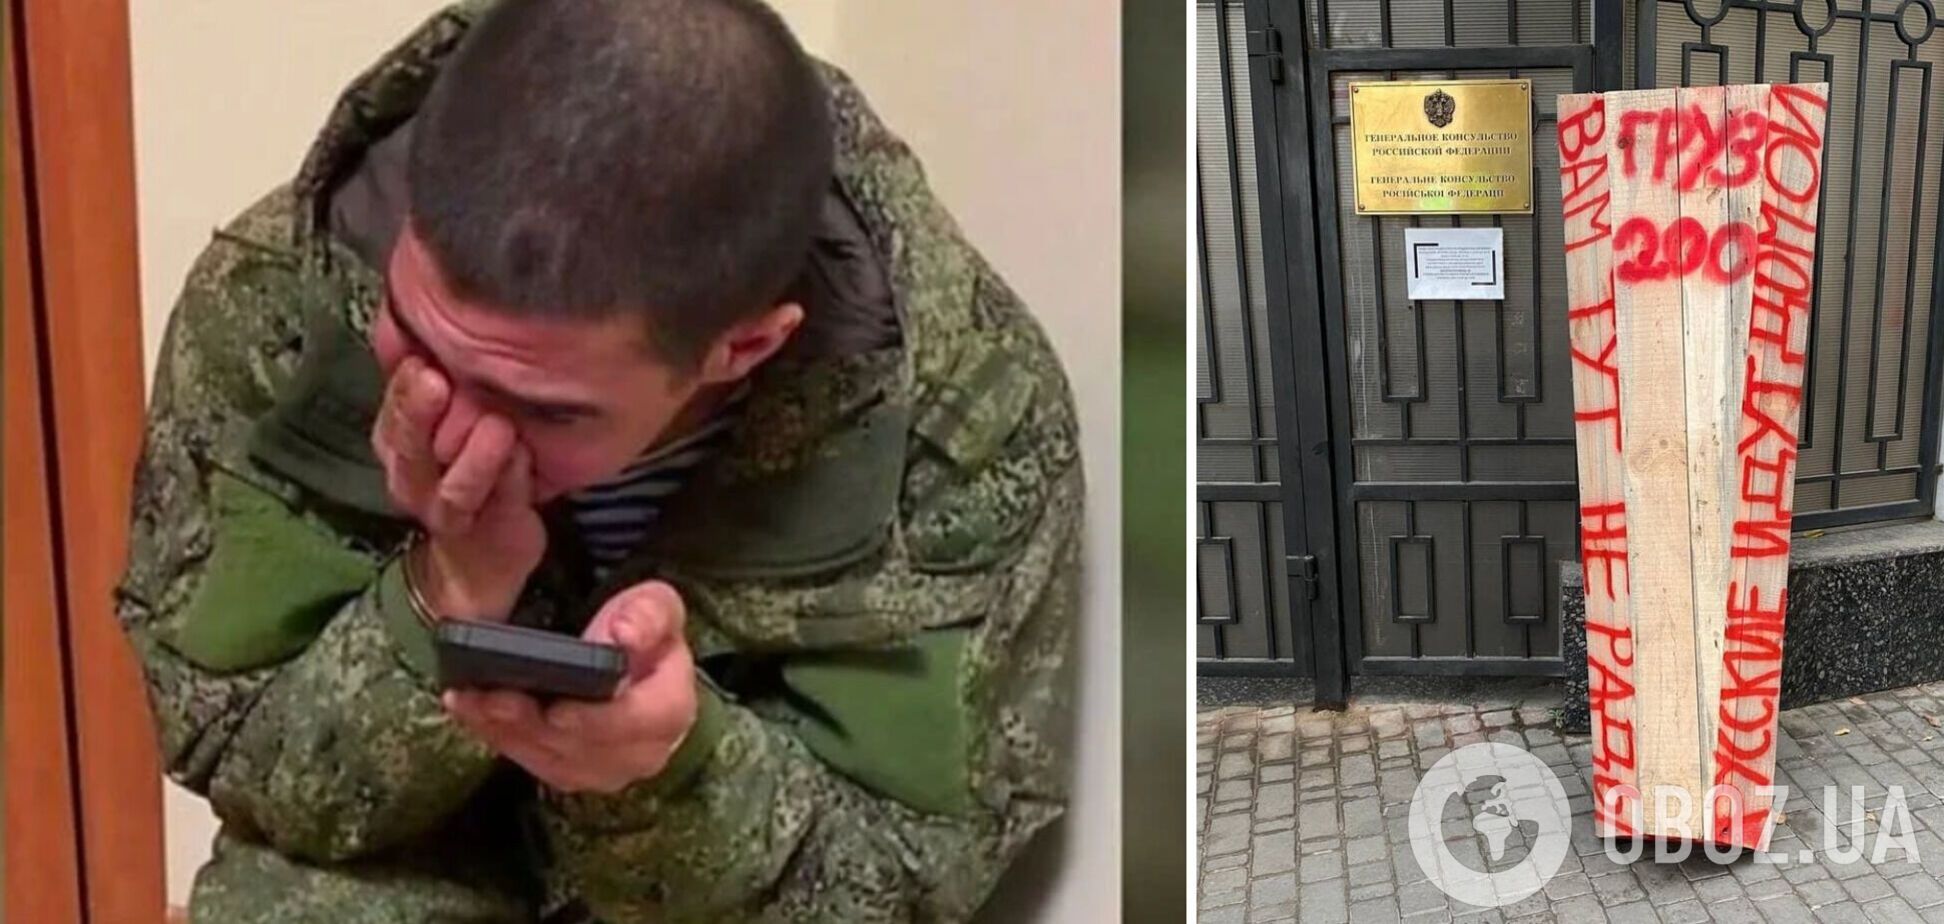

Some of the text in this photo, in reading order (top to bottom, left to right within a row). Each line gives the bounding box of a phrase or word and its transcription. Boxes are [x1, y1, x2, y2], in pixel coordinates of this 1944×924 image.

[1365, 132, 1518, 142] ГЕНЕРАЛЬНОЕ КОНСУЛЬСТВО
[1372, 146, 1511, 156] РОССИЙСКОЙ ФЕДЕРАЦИИ
[1617, 104, 1769, 191] ГРУЗ
[1370, 175, 1515, 184] ГЕНЕРАЛЬНЕ КОНСУЛЬСТВО
[1613, 216, 1758, 284] 200
[1558, 99, 1639, 836] ВАМ ТУТ НЕ РАДЫ
[1730, 355, 1802, 558] ИДУТ
